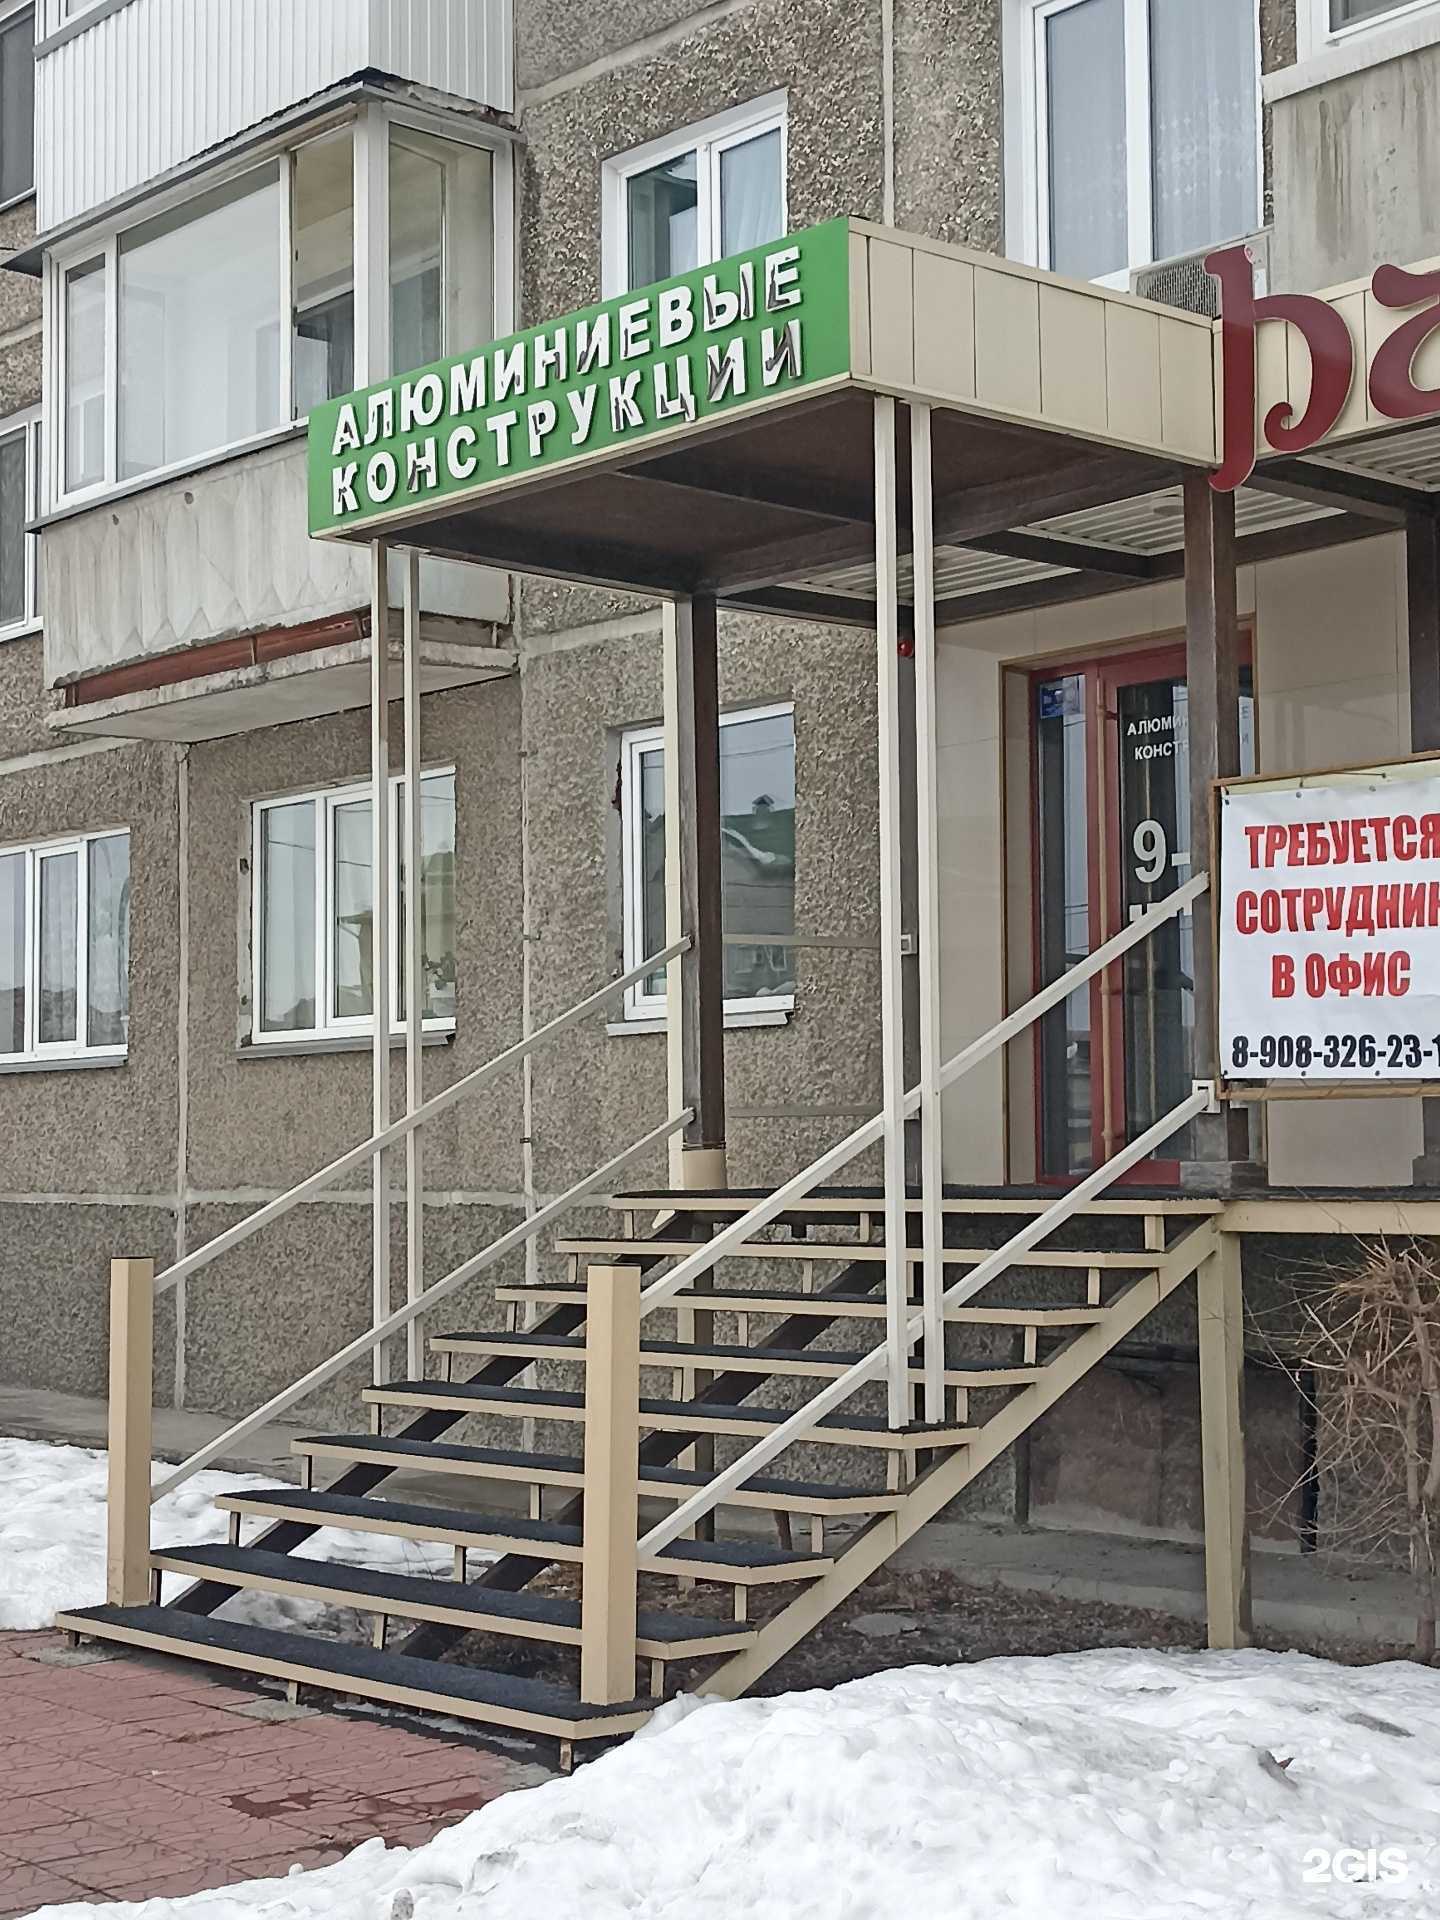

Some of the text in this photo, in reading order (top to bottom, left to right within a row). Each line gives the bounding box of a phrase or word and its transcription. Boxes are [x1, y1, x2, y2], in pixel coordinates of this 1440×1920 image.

[331, 246, 802, 456] АЛЮМИНИЕВЫЕ
[331, 319, 802, 516] КОНСТРУКЦИИ
[1245, 813, 1440, 869] ТРЕБУЕТСЯ
[1272, 951, 1411, 998] В ОФИС
